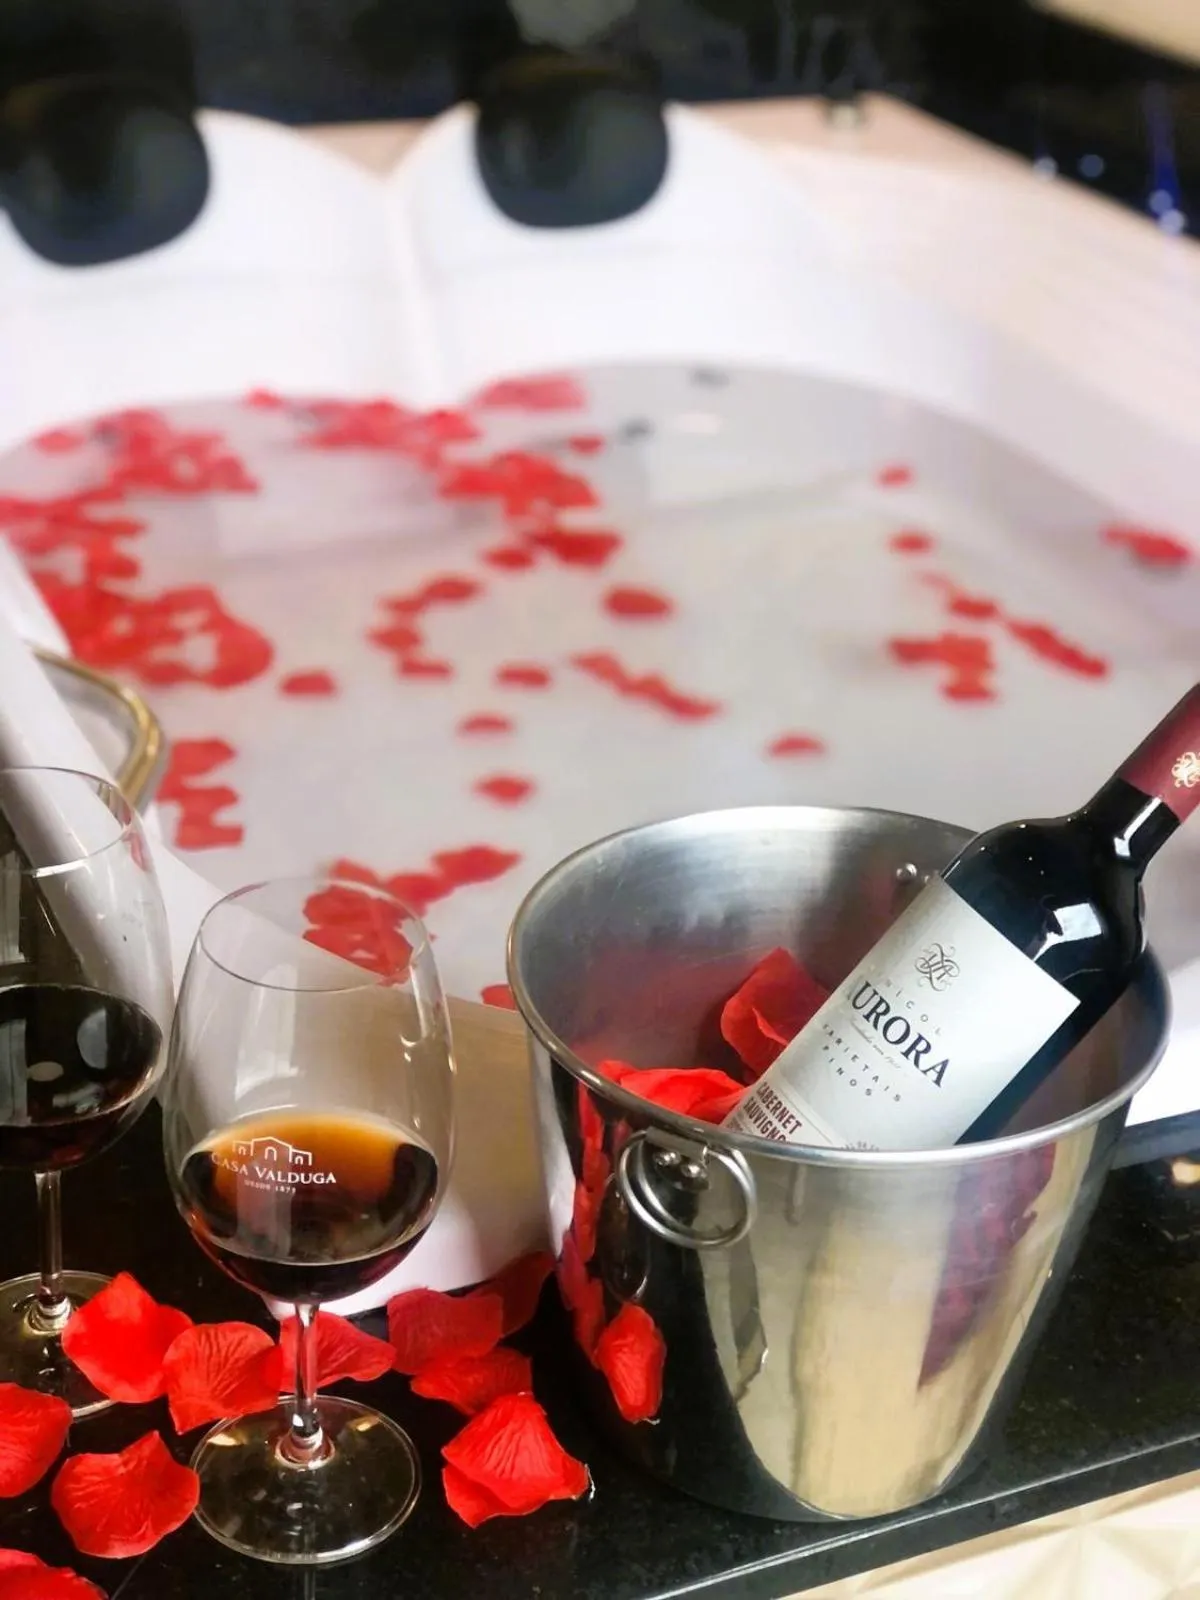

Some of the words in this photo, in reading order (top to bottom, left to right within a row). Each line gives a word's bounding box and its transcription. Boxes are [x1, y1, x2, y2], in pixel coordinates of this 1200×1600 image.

[848, 980, 950, 1088] URORA
[211, 1152, 249, 1176] CASA
[255, 1166, 337, 1185] VALDUGA
